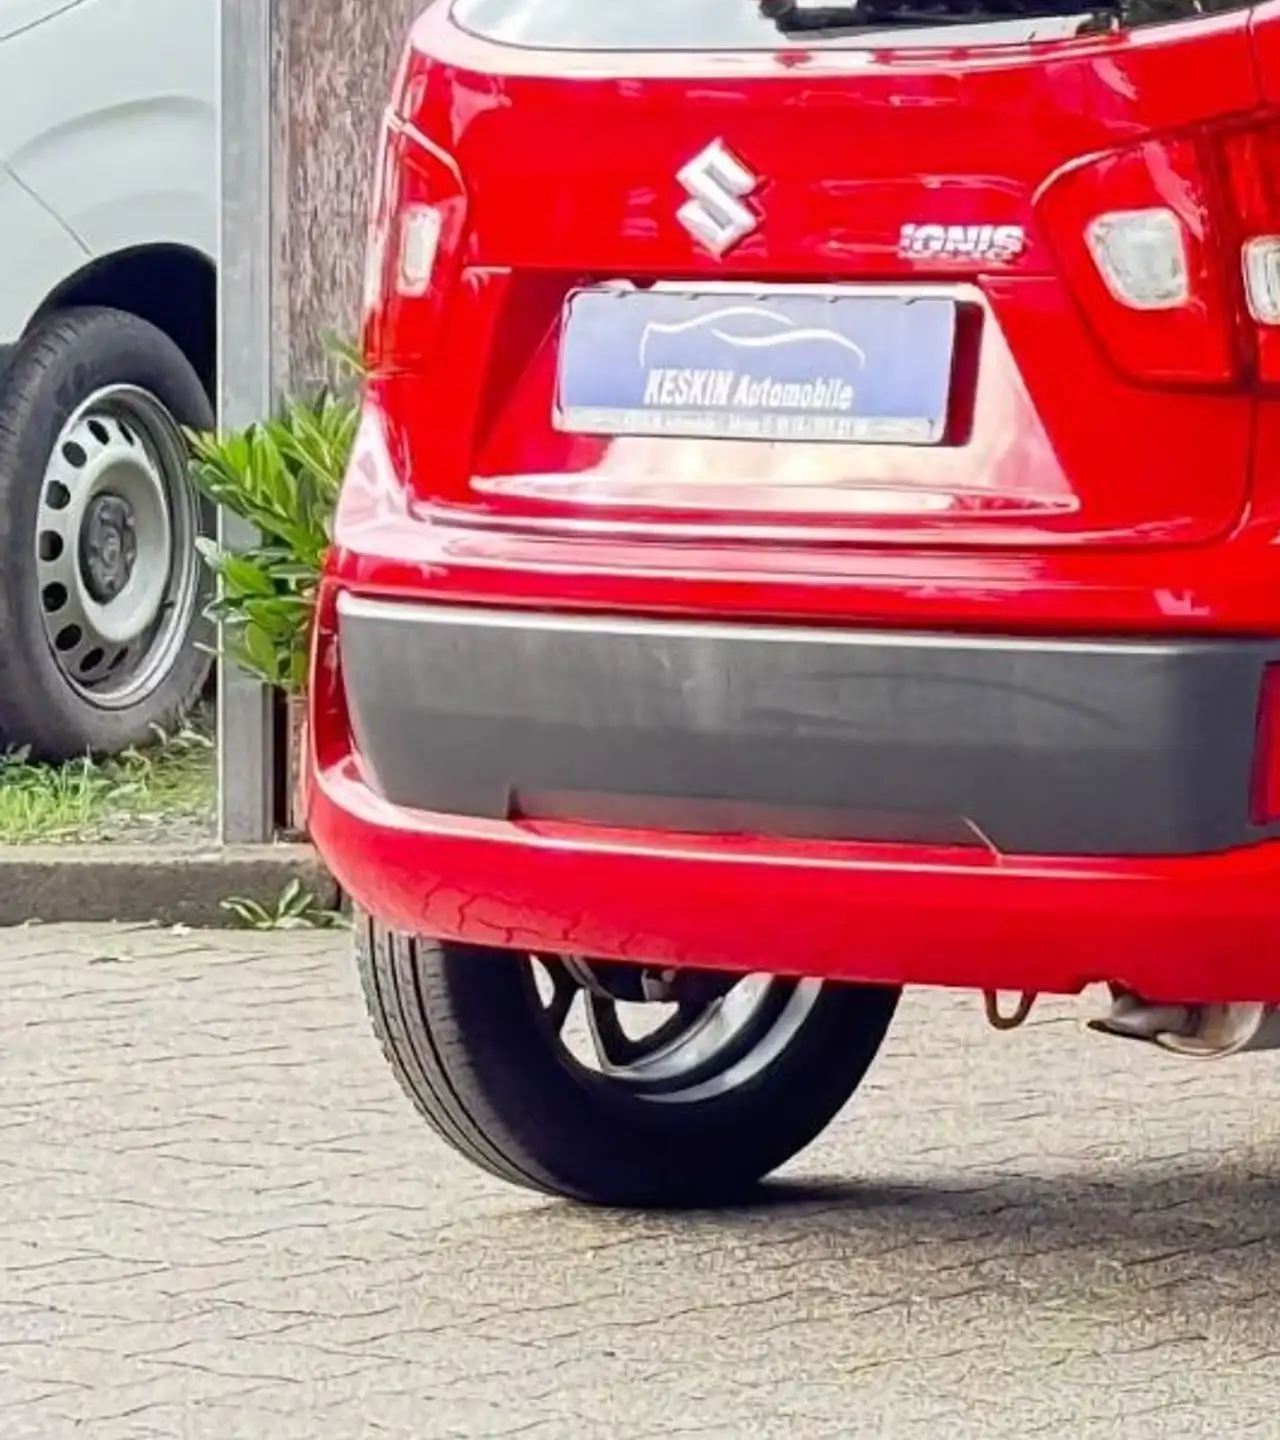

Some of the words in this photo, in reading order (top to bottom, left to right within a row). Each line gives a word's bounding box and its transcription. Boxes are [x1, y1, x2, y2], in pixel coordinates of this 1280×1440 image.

[899, 224, 1025, 260] IGNIS
[643, 367, 733, 407] KESKIN
[733, 373, 854, 411] Automobile
